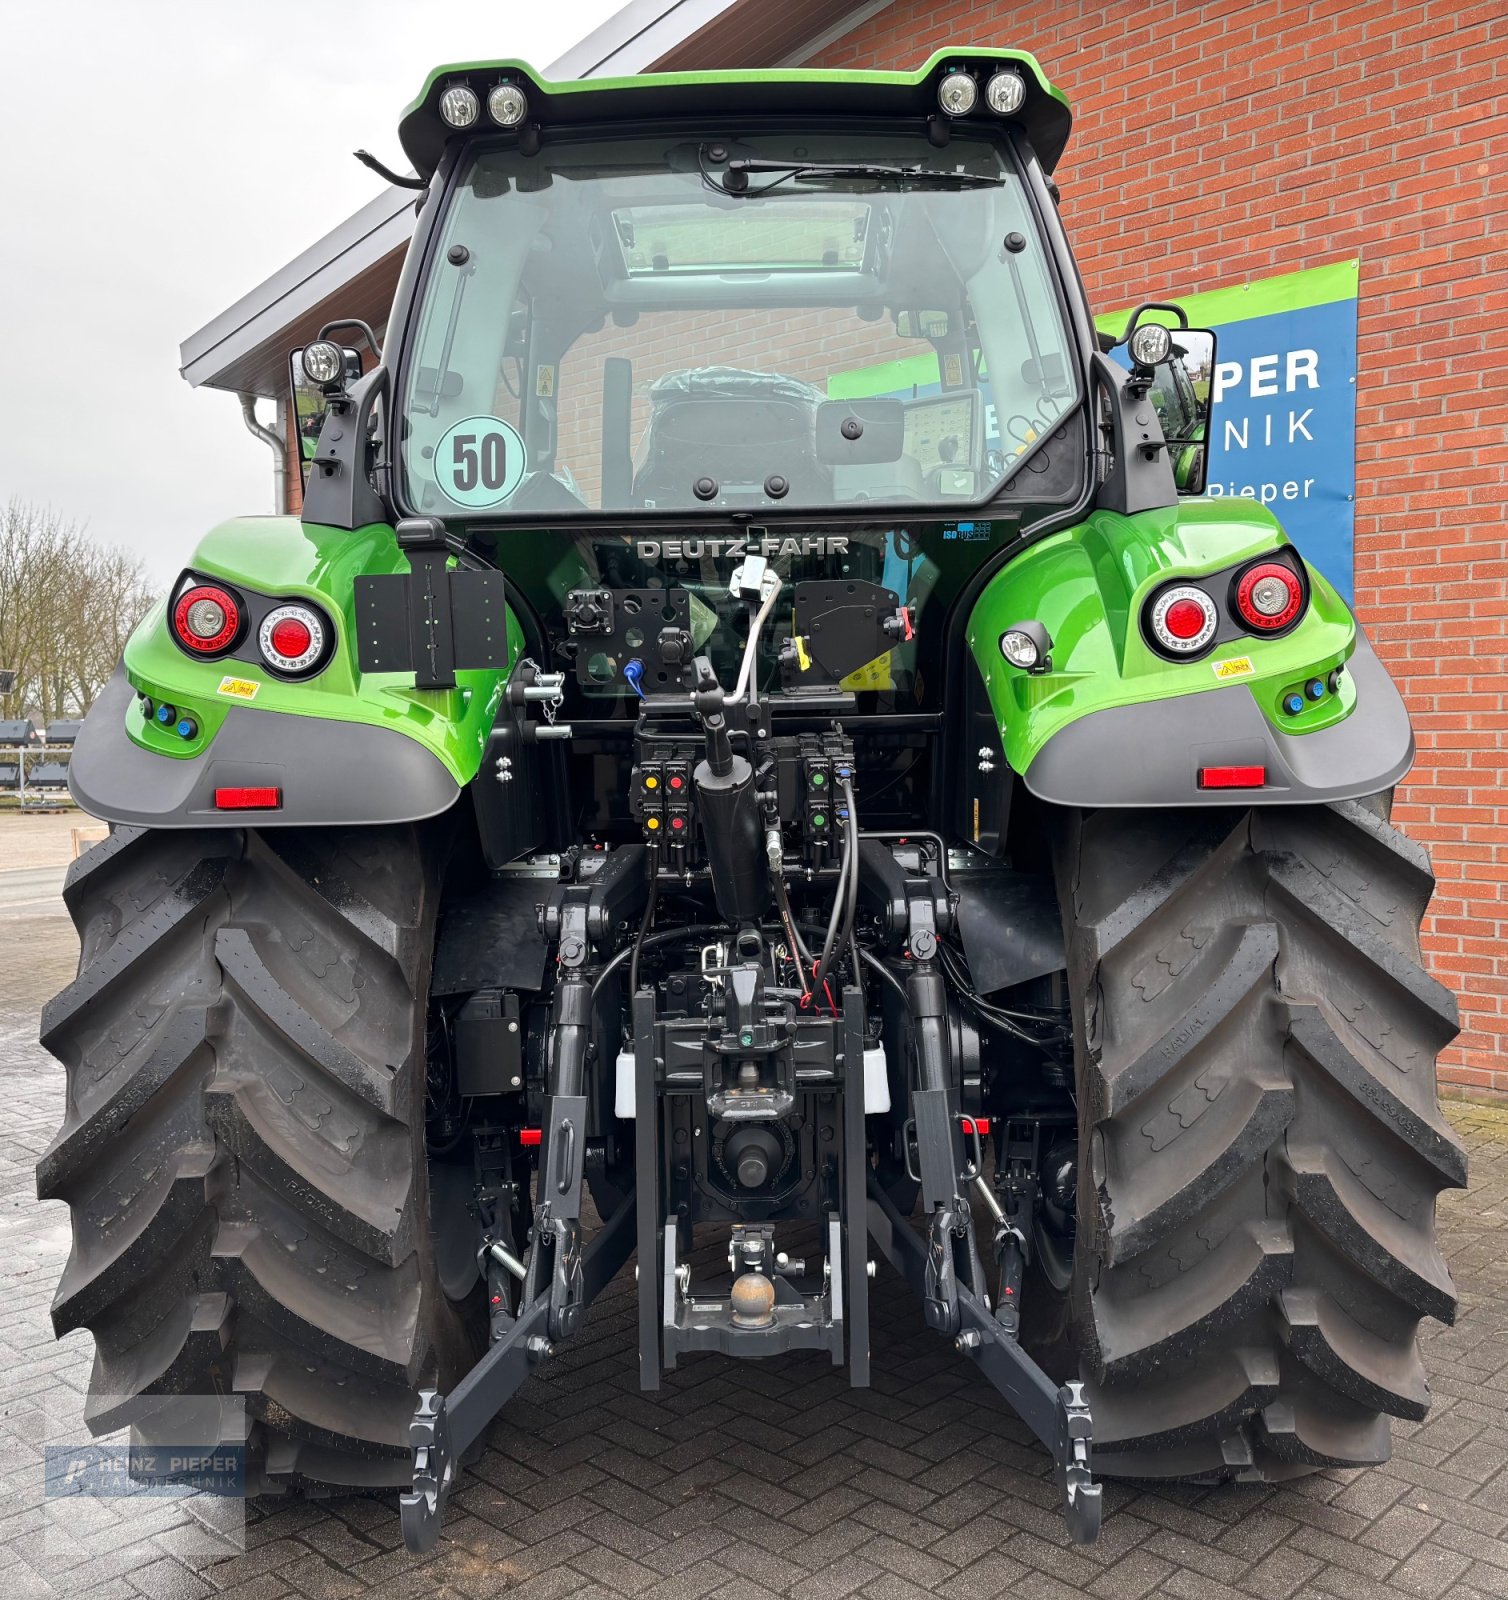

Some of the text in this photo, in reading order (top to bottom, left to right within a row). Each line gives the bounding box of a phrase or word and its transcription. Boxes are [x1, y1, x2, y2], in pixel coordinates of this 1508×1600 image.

[452, 432, 507, 492] 50
[636, 536, 849, 560] DEUTZ-FAHR
[1160, 1018, 1209, 1058] RADIAL
